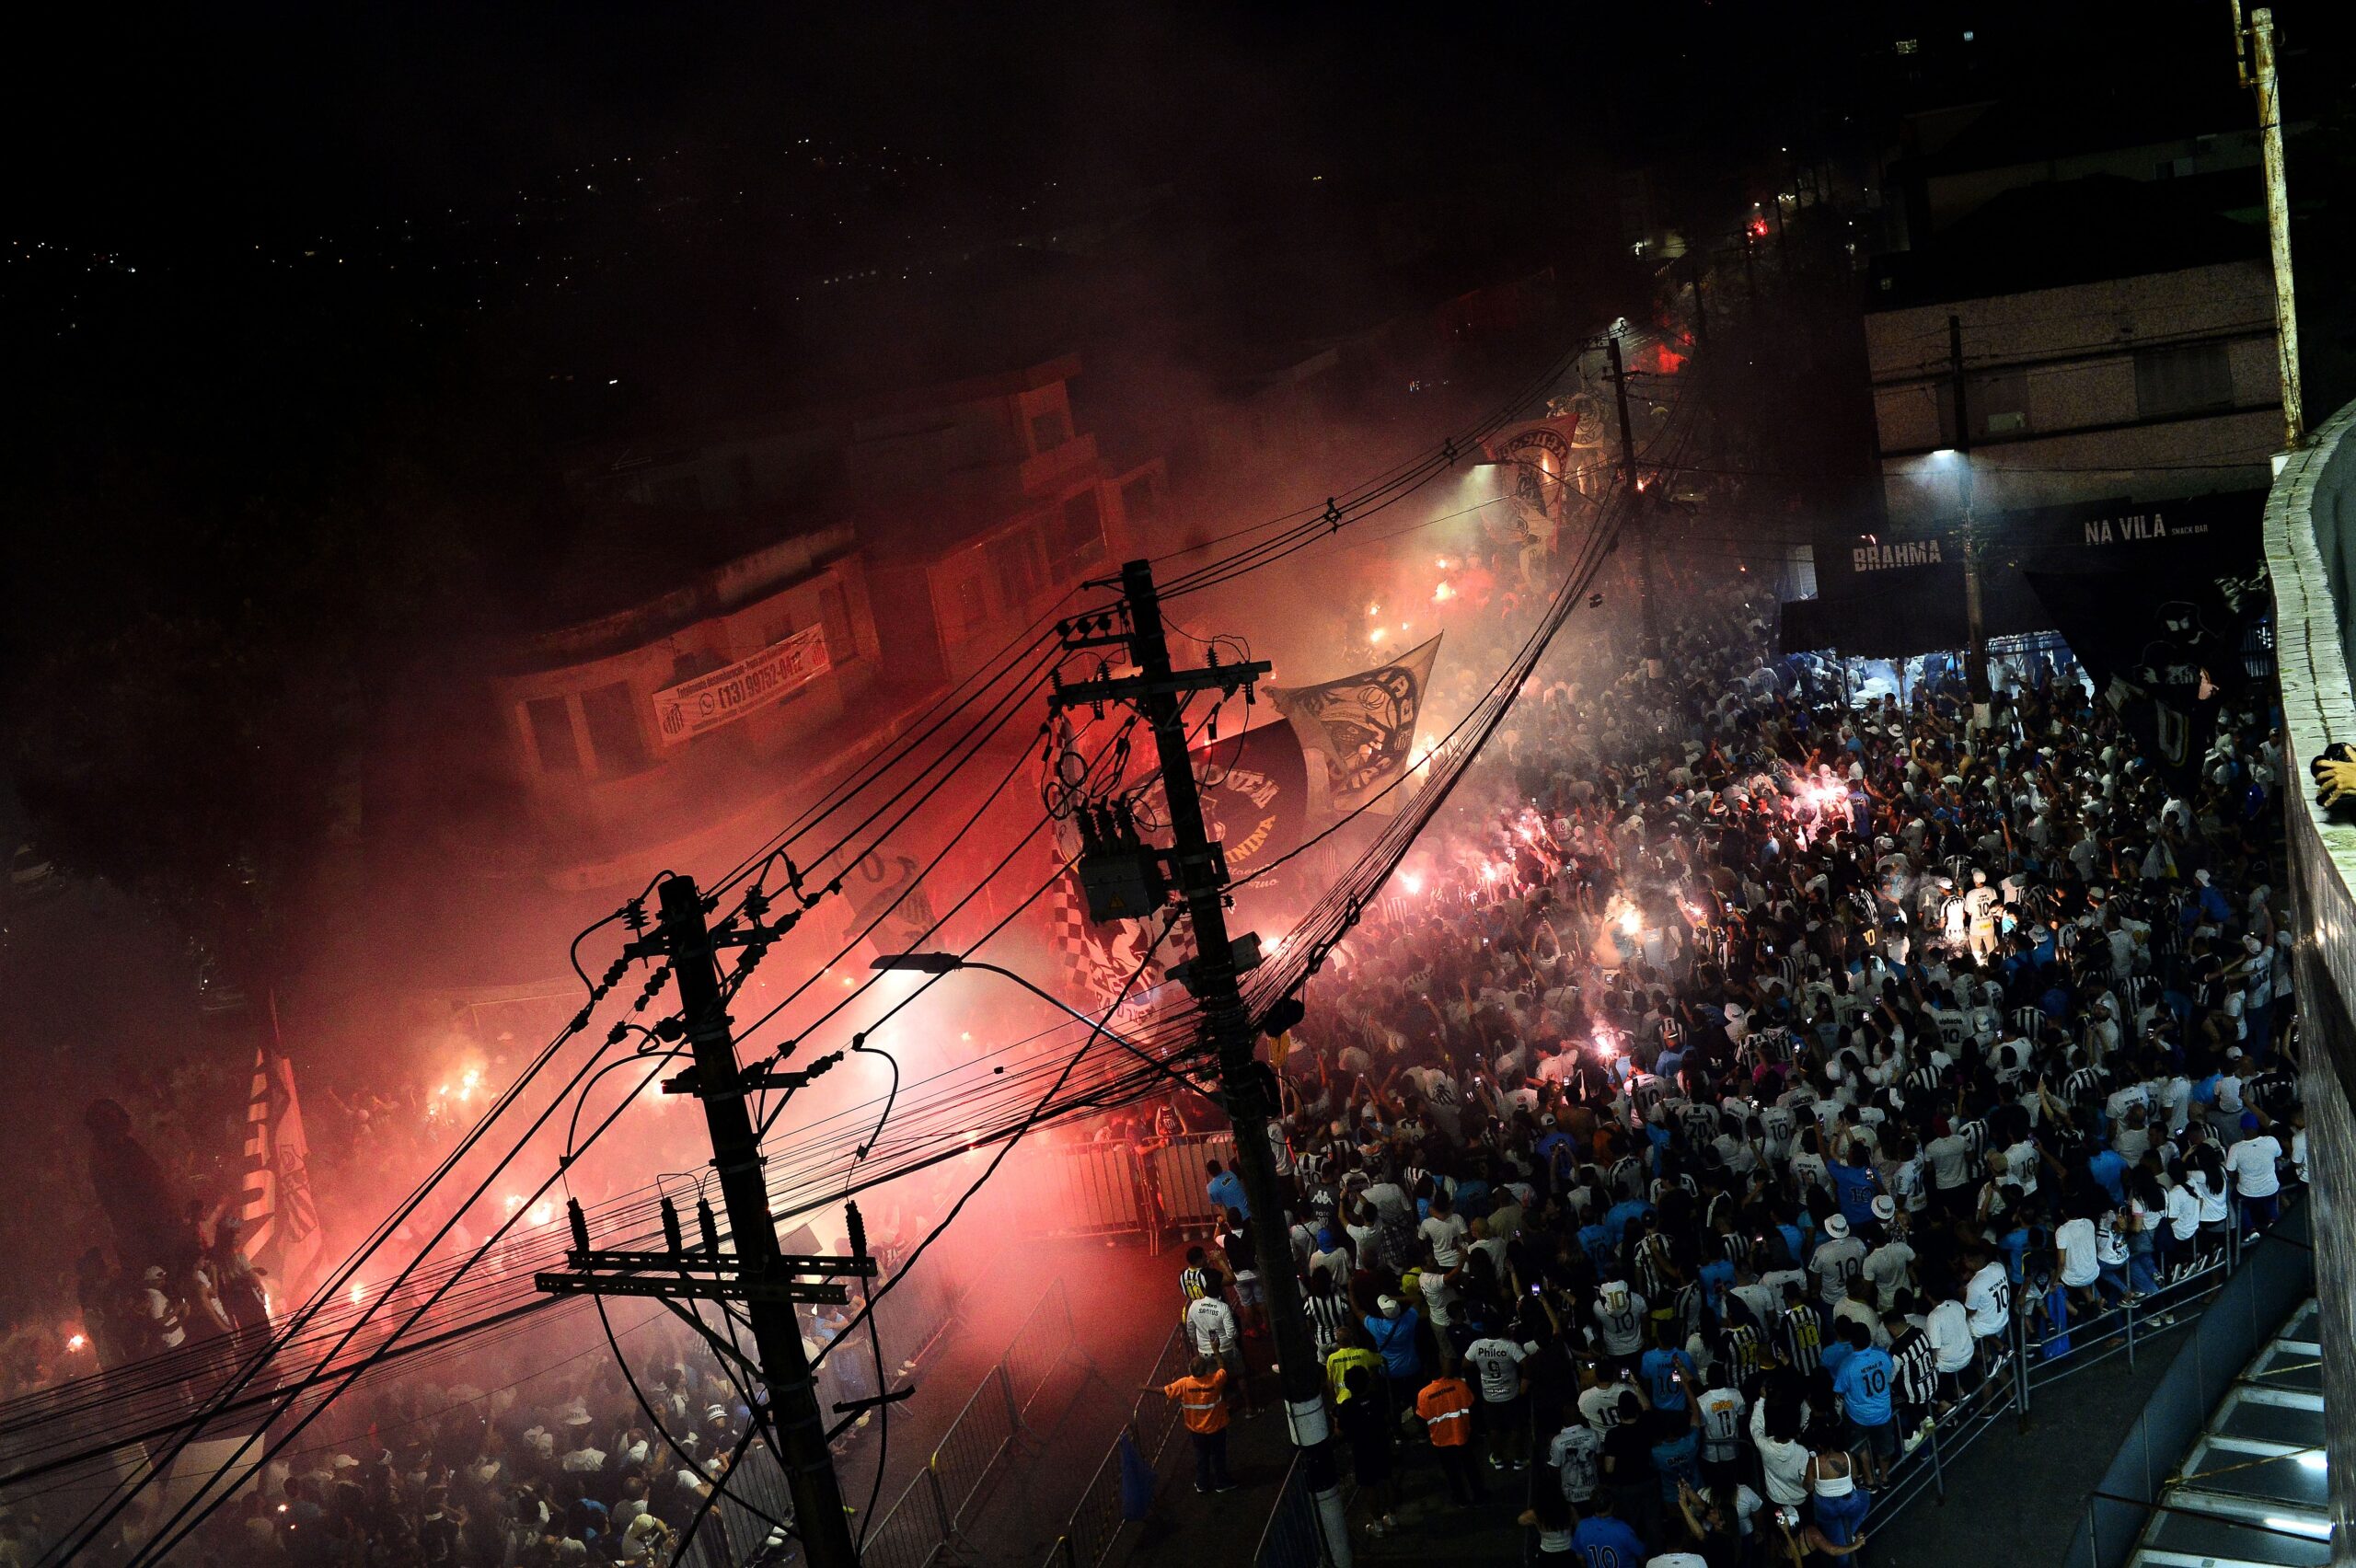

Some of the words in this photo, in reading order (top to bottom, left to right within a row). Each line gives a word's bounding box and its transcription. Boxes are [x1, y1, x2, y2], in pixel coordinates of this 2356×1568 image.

[2085, 519, 2114, 546] NA
[2118, 513, 2166, 542] VILA
[1853, 539, 1942, 572] BRAHMA
[1195, 761, 1281, 809] OVEM
[1225, 815, 1277, 864] ININA
[1977, 902, 1990, 918] 10
[1862, 928, 1876, 947] 10
[1942, 1028, 1960, 1043] 10
[1639, 1089, 1660, 1105] 10
[1770, 1123, 1788, 1143] 10
[2020, 1157, 2036, 1179] 10
[1835, 1257, 1858, 1283] 10
[1607, 1290, 1626, 1309] 10
[1992, 1285, 2009, 1313] 10
[1613, 1312, 1635, 1334] 10
[1478, 1347, 1507, 1357] Philco
[1487, 1360, 1501, 1379] 9
[1915, 1351, 1934, 1378] 10
[1862, 1369, 1886, 1399] 10
[1588, 1544, 1620, 1568] 10
